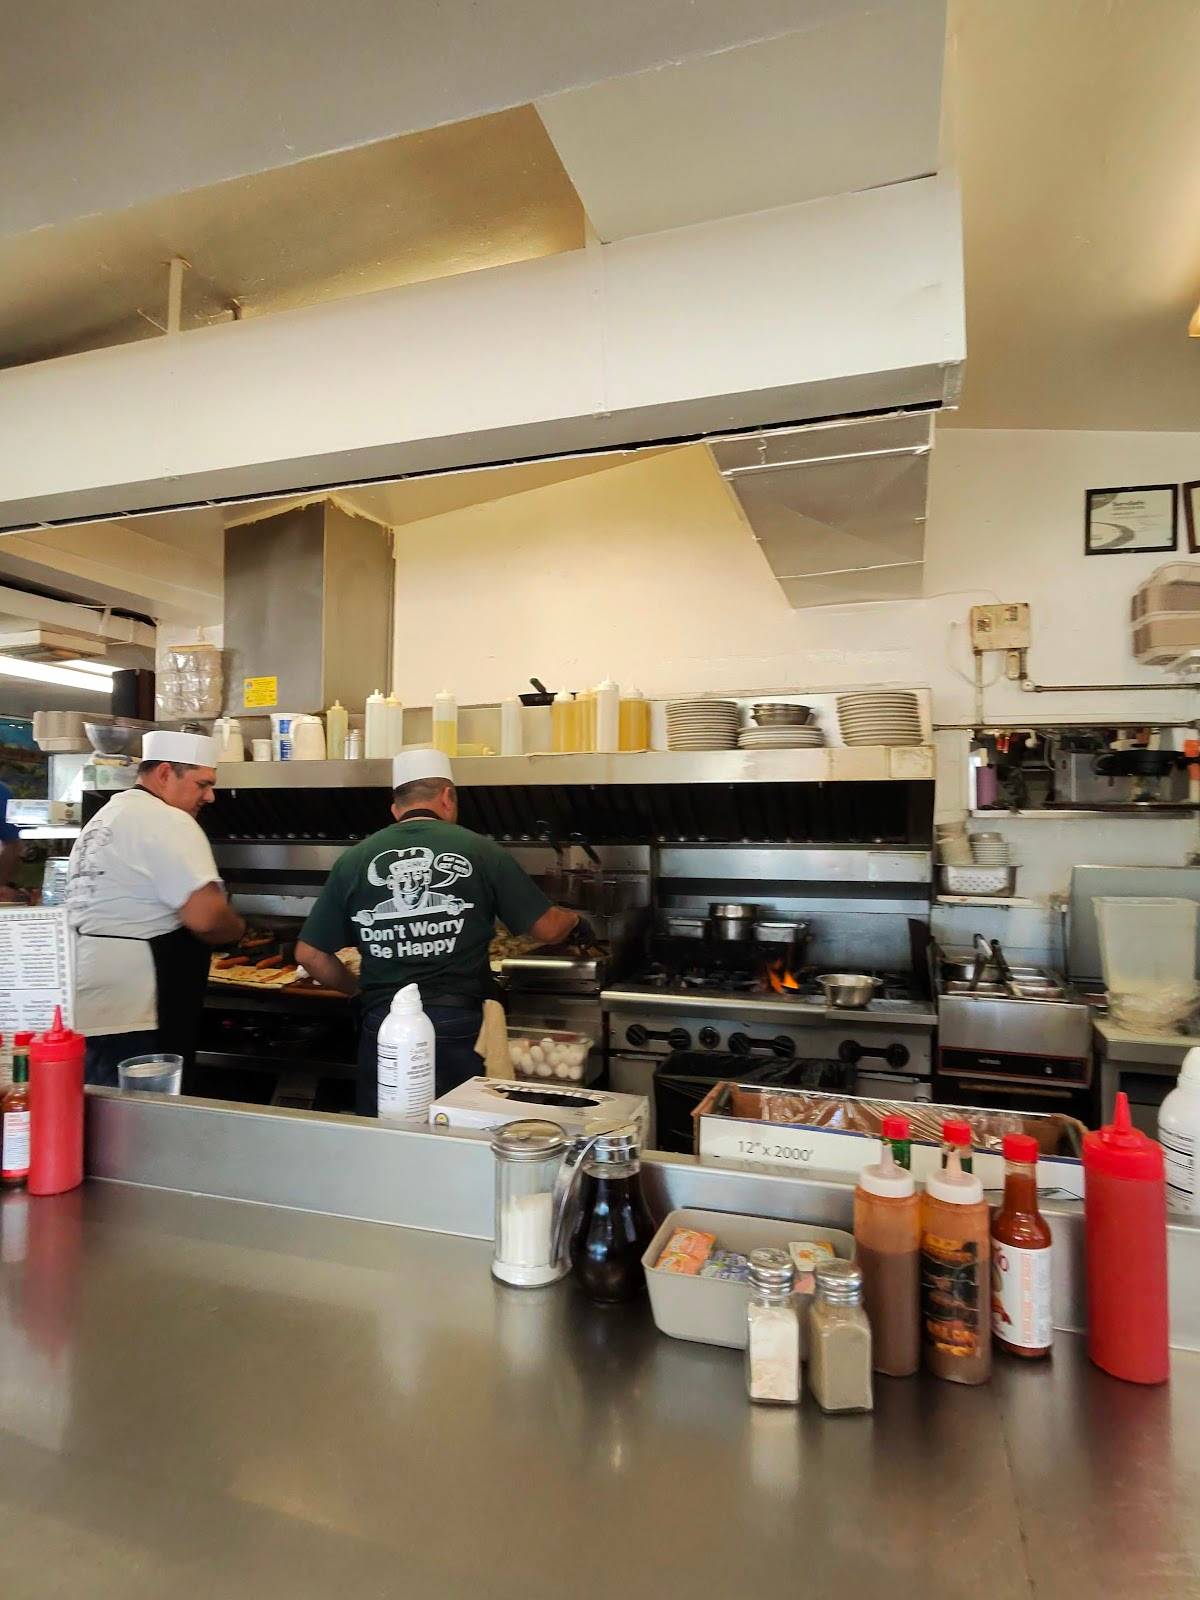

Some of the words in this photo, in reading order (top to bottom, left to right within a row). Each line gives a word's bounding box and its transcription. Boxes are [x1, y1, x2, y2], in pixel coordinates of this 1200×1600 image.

[360, 924, 406, 942] Don't
[409, 918, 465, 936] Worry
[369, 943, 393, 959] Be
[397, 937, 457, 958] Happy
[738, 1140, 761, 1154] 12"
